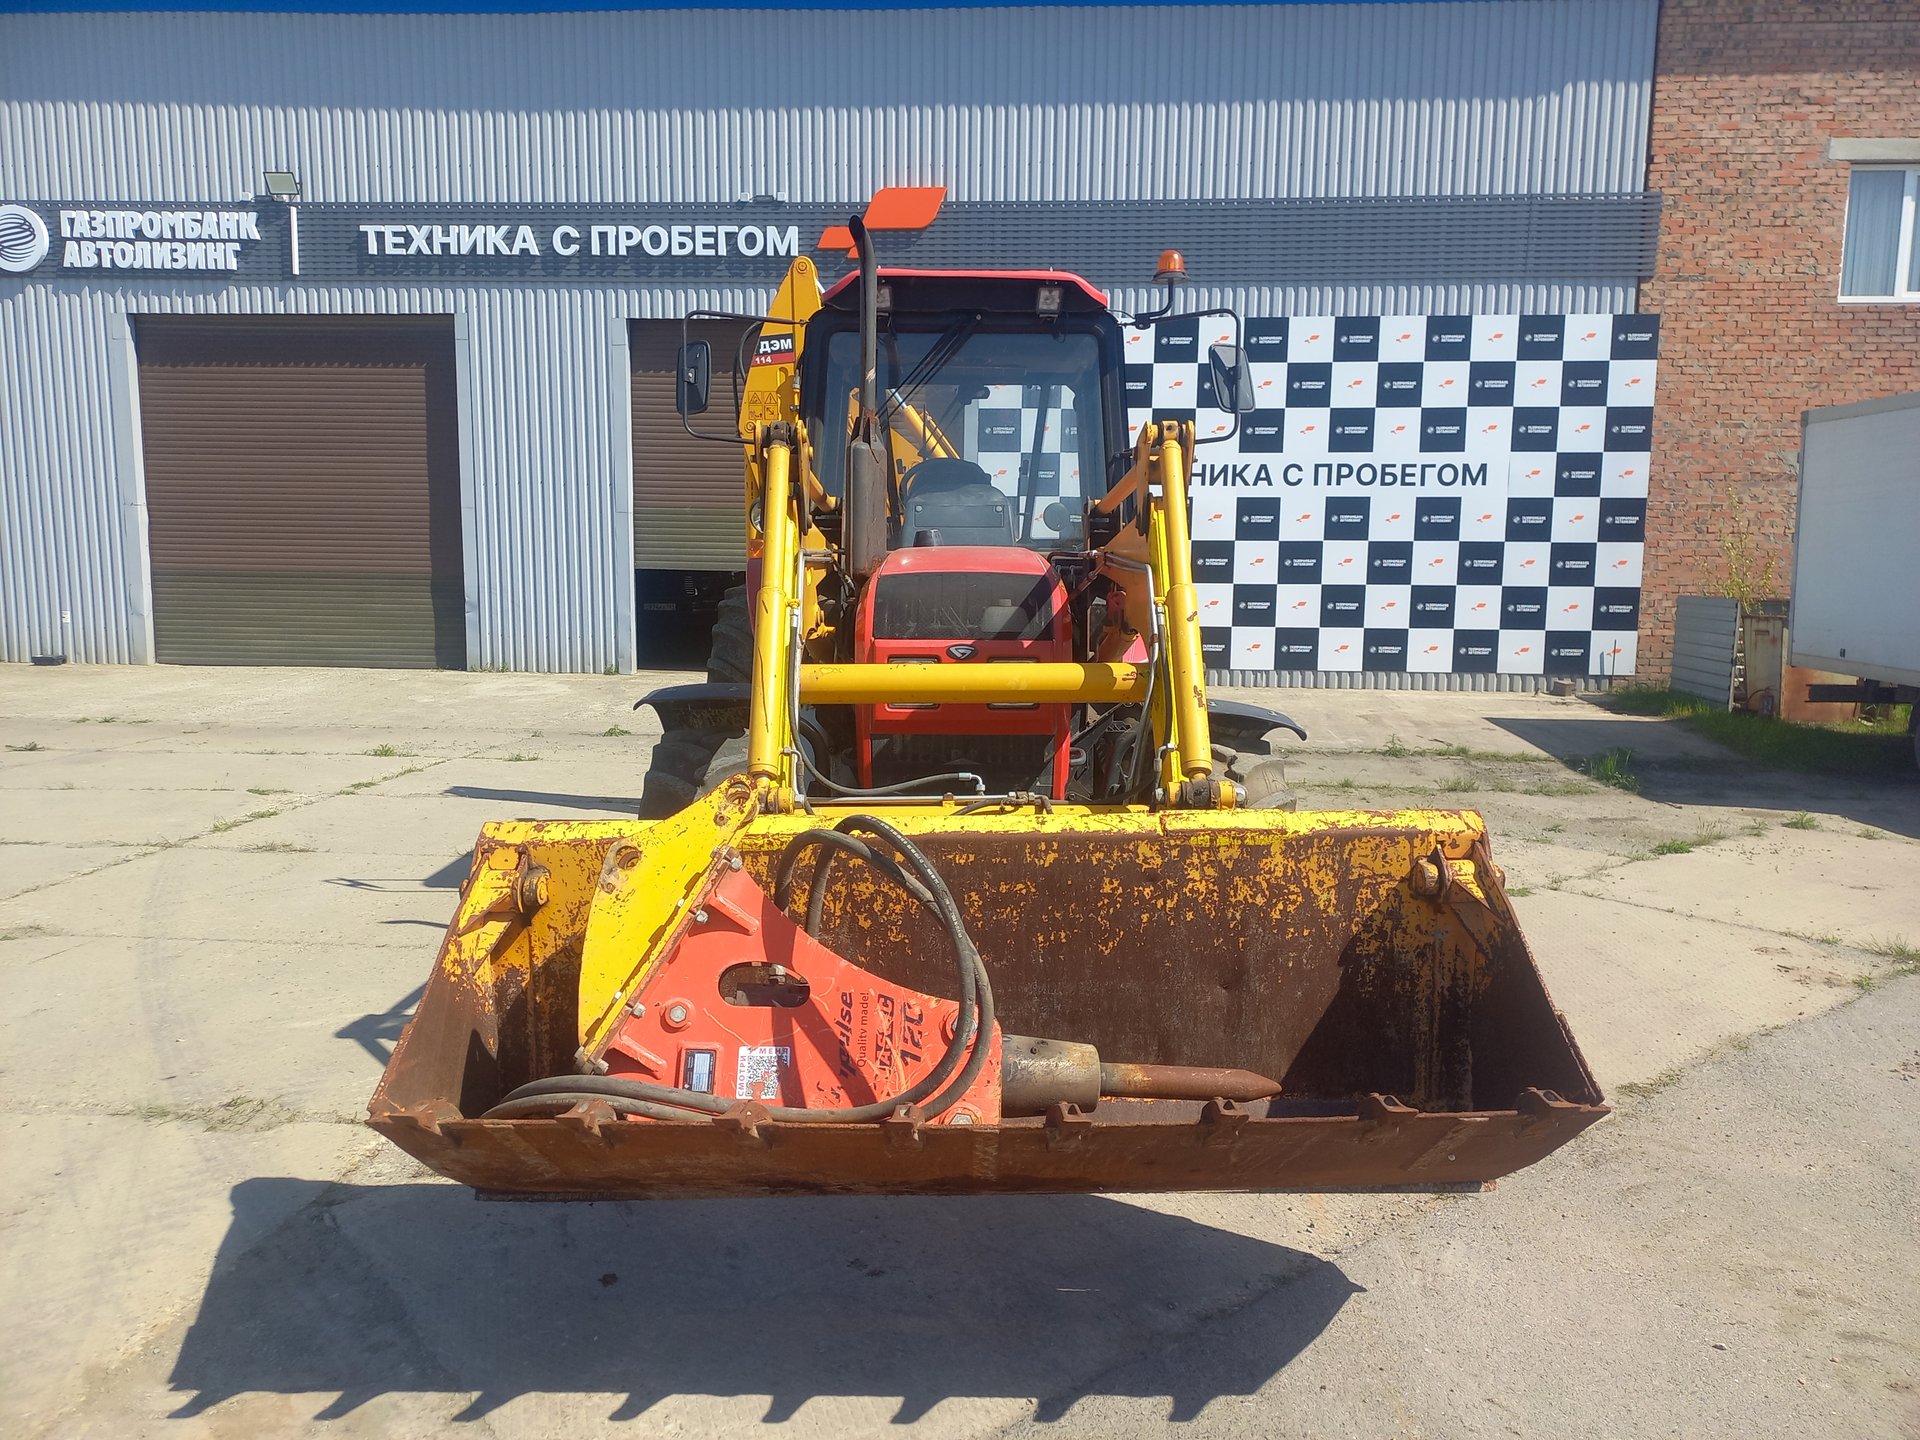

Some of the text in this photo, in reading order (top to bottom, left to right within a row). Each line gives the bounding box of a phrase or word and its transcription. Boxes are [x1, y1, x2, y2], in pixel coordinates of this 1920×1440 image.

[59, 209, 261, 241] ГАЗПРОМБАНК
[359, 224, 799, 256] ТЕХНИКА С ПРОБЕГОМ
[63, 240, 241, 271] АВТОЛИЗИНГ
[755, 355, 772, 364] 114
[759, 338, 792, 353] ДЭМ
[1189, 463, 1488, 487] НИКА С ПРОБЕГОМ
[860, 992, 869, 1026] made!
[738, 1055, 747, 1097] СМОТРИ
